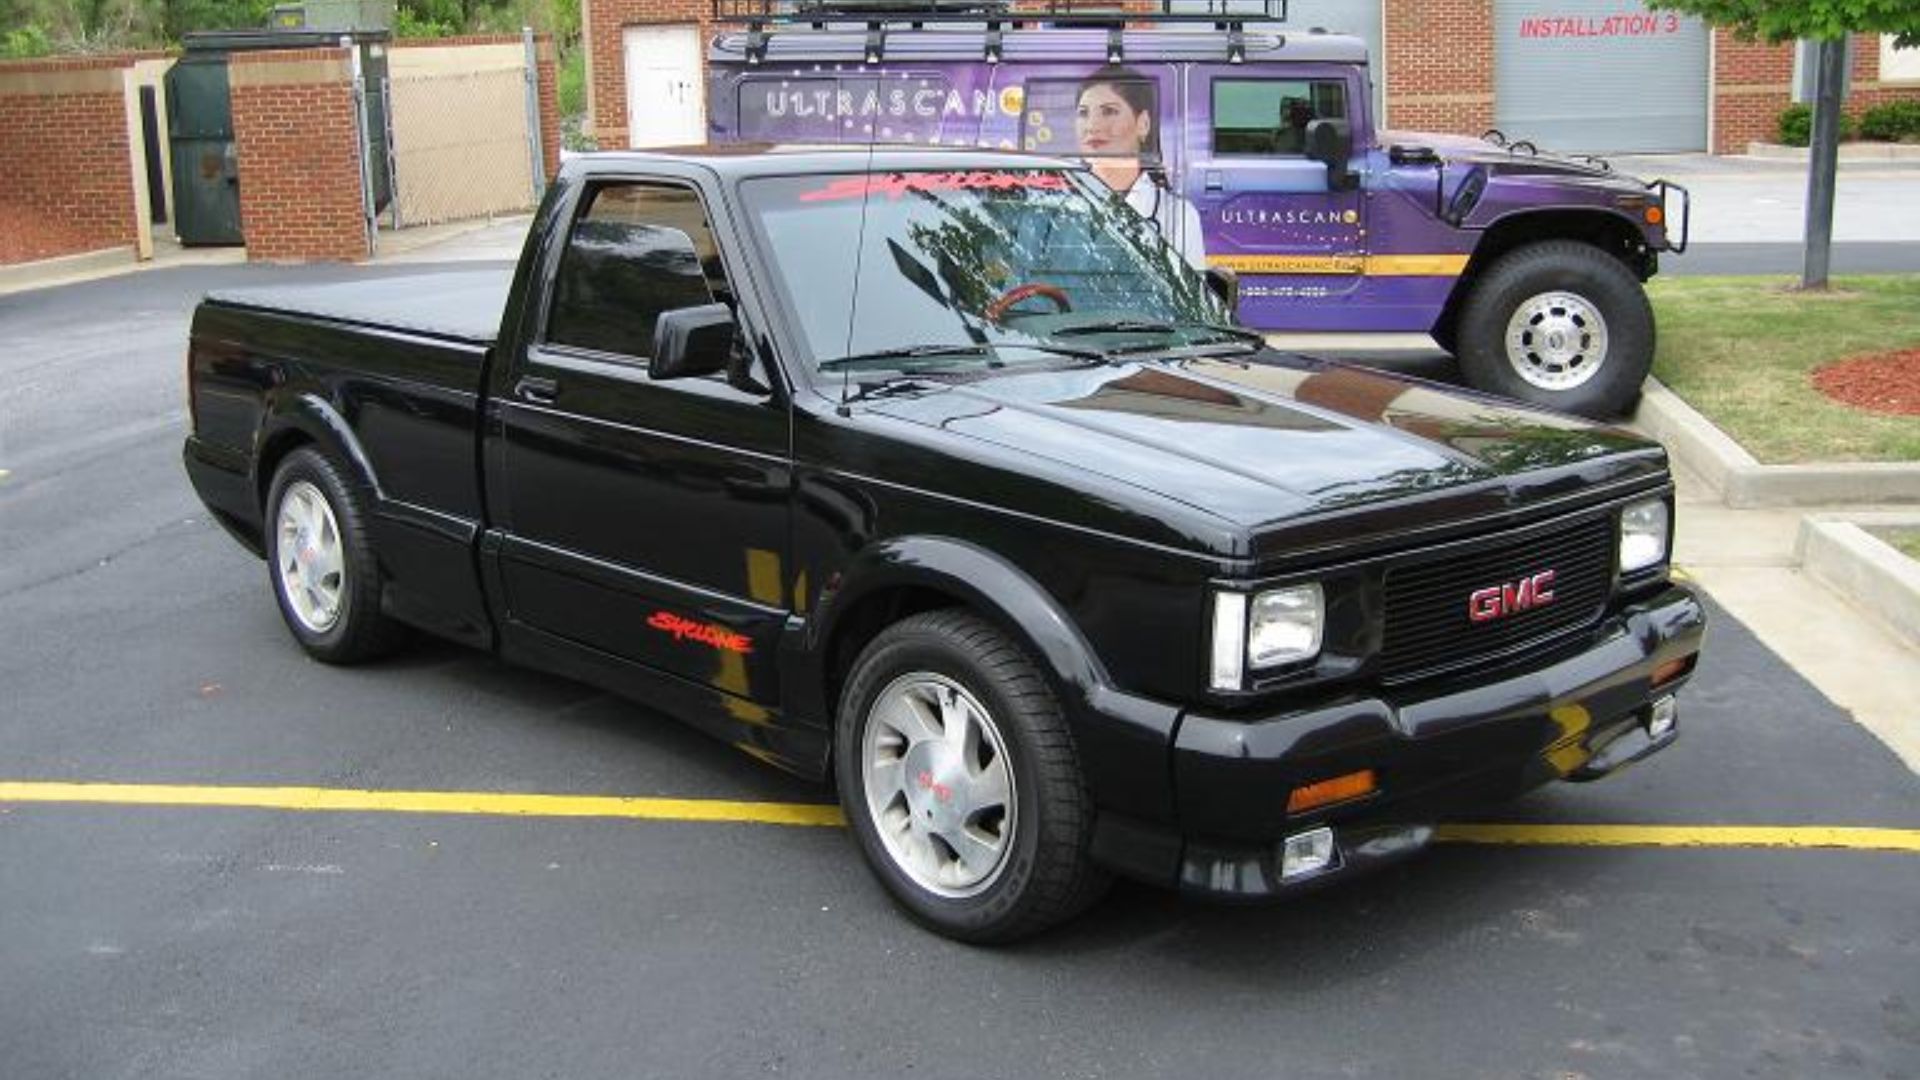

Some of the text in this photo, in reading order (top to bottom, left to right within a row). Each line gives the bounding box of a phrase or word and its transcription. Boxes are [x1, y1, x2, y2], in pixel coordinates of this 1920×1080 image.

[1519, 14, 1678, 38] INSTALLATION 3
[766, 88, 996, 117] ULTRASCAN
[1221, 209, 1340, 223] ULTRASCAN
[1469, 570, 1555, 621] GMC
